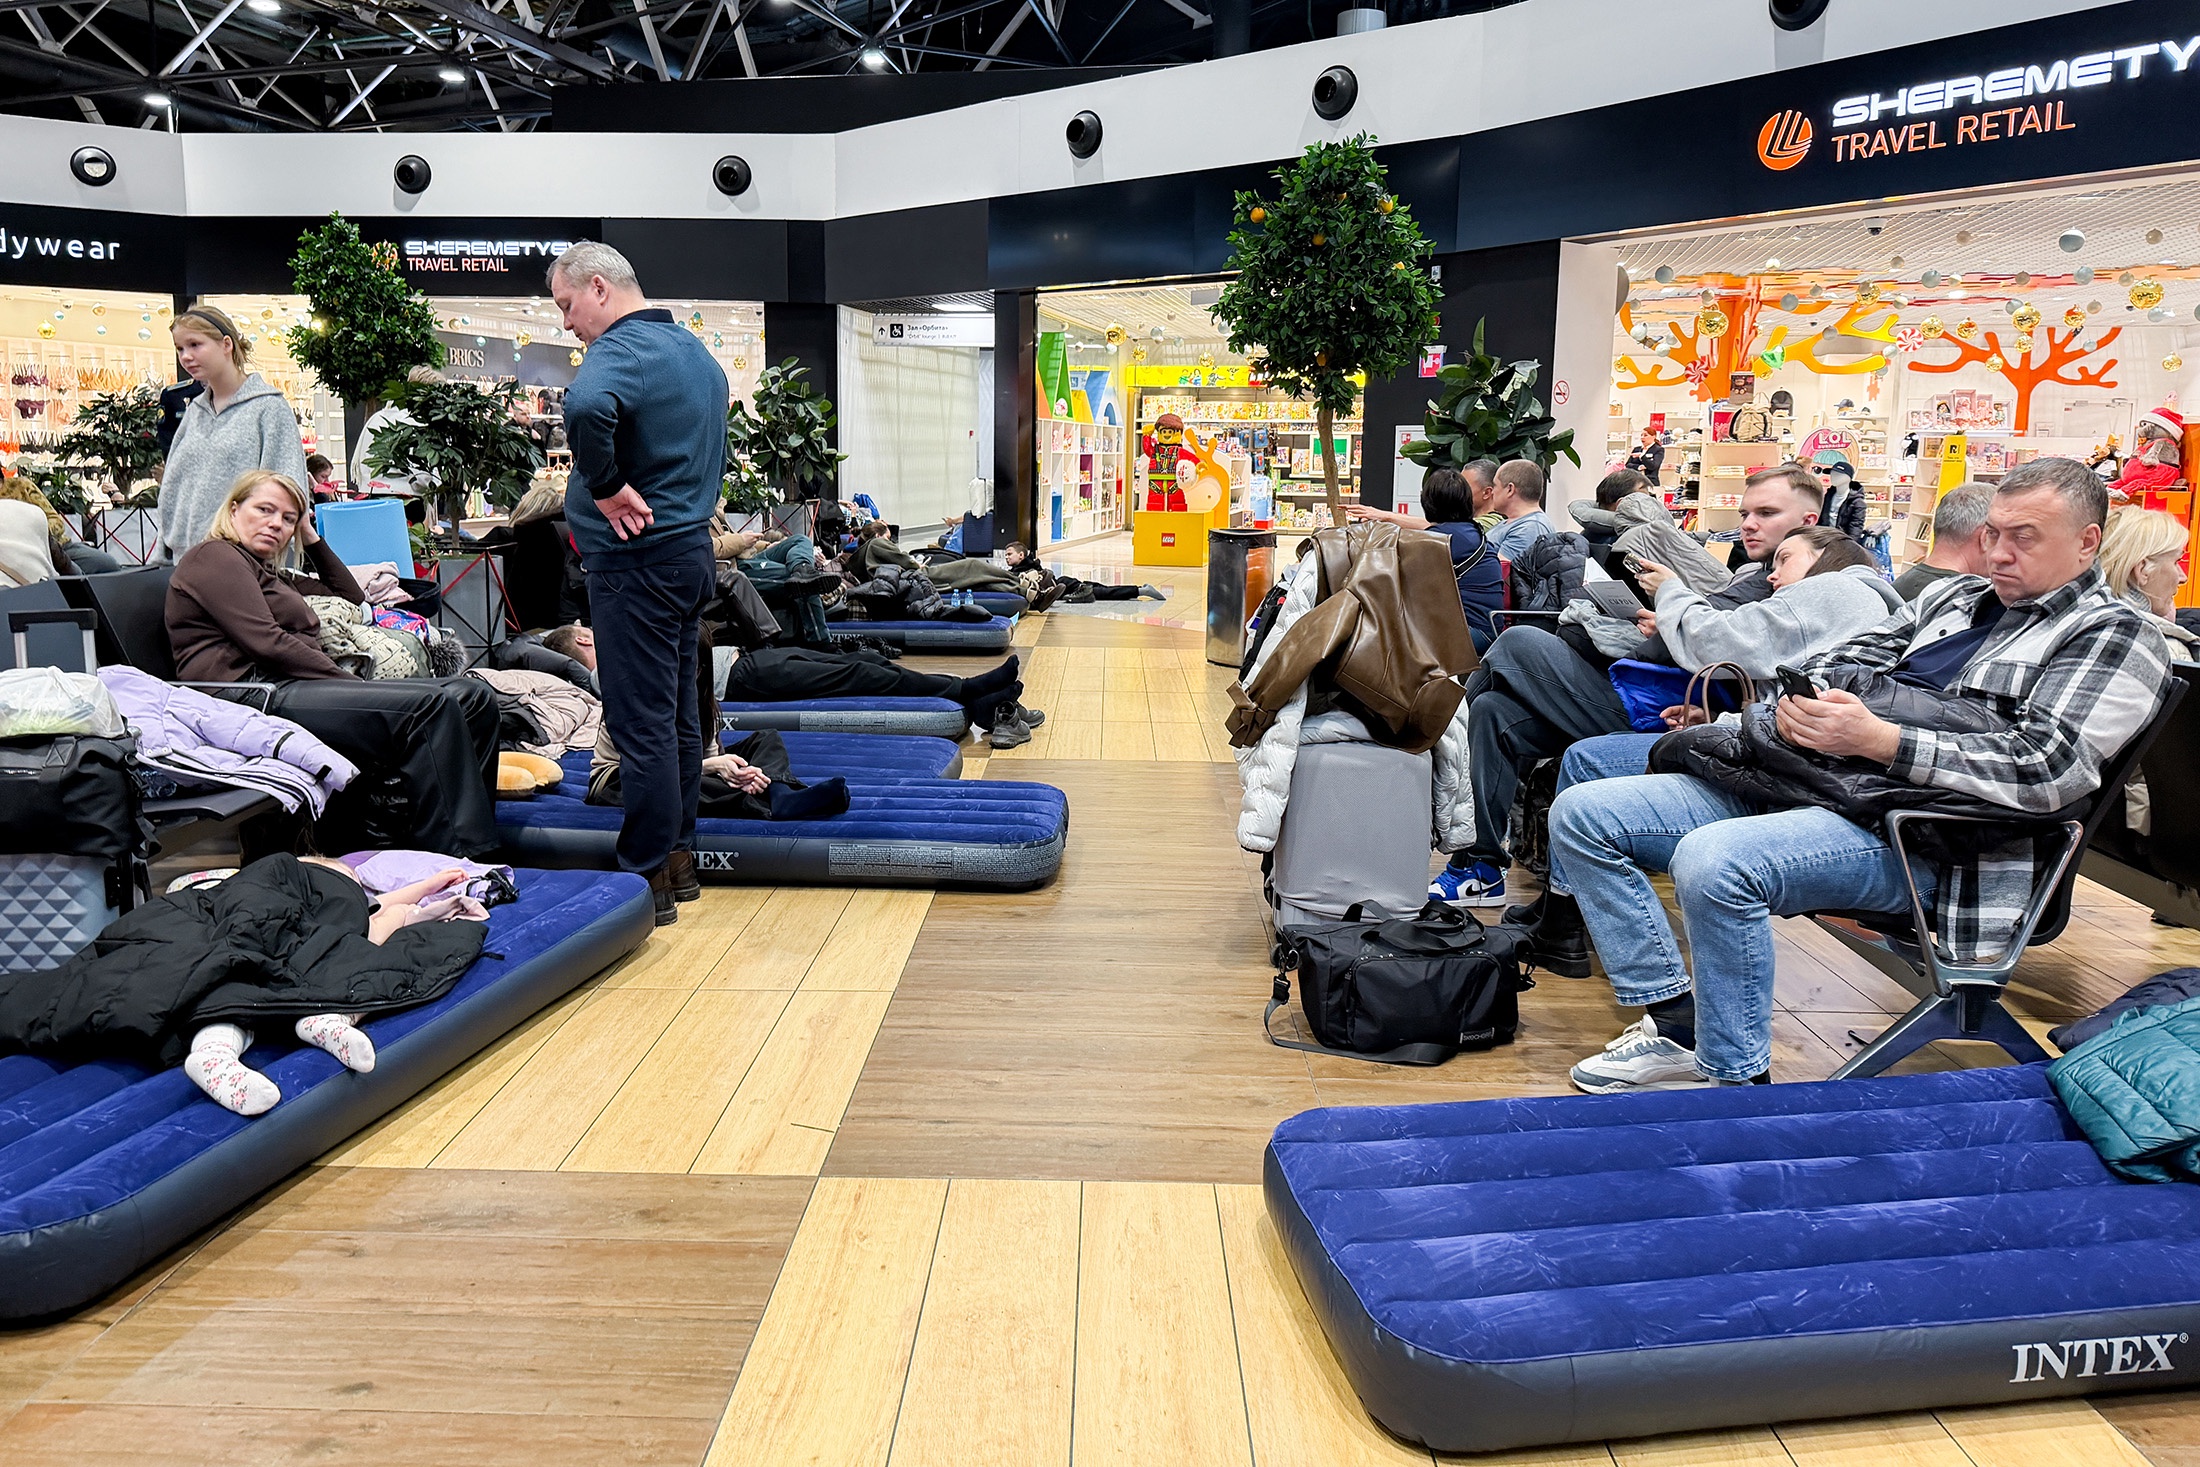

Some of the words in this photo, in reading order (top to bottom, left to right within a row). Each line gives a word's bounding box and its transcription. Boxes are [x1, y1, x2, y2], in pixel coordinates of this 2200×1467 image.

[1831, 36, 2200, 128] SHEREMETY
[1831, 121, 1947, 162] TRAVEL
[1957, 100, 2076, 145] RETAIL
[406, 257, 458, 272] TRAVEL
[462, 257, 509, 272] RETAIL
